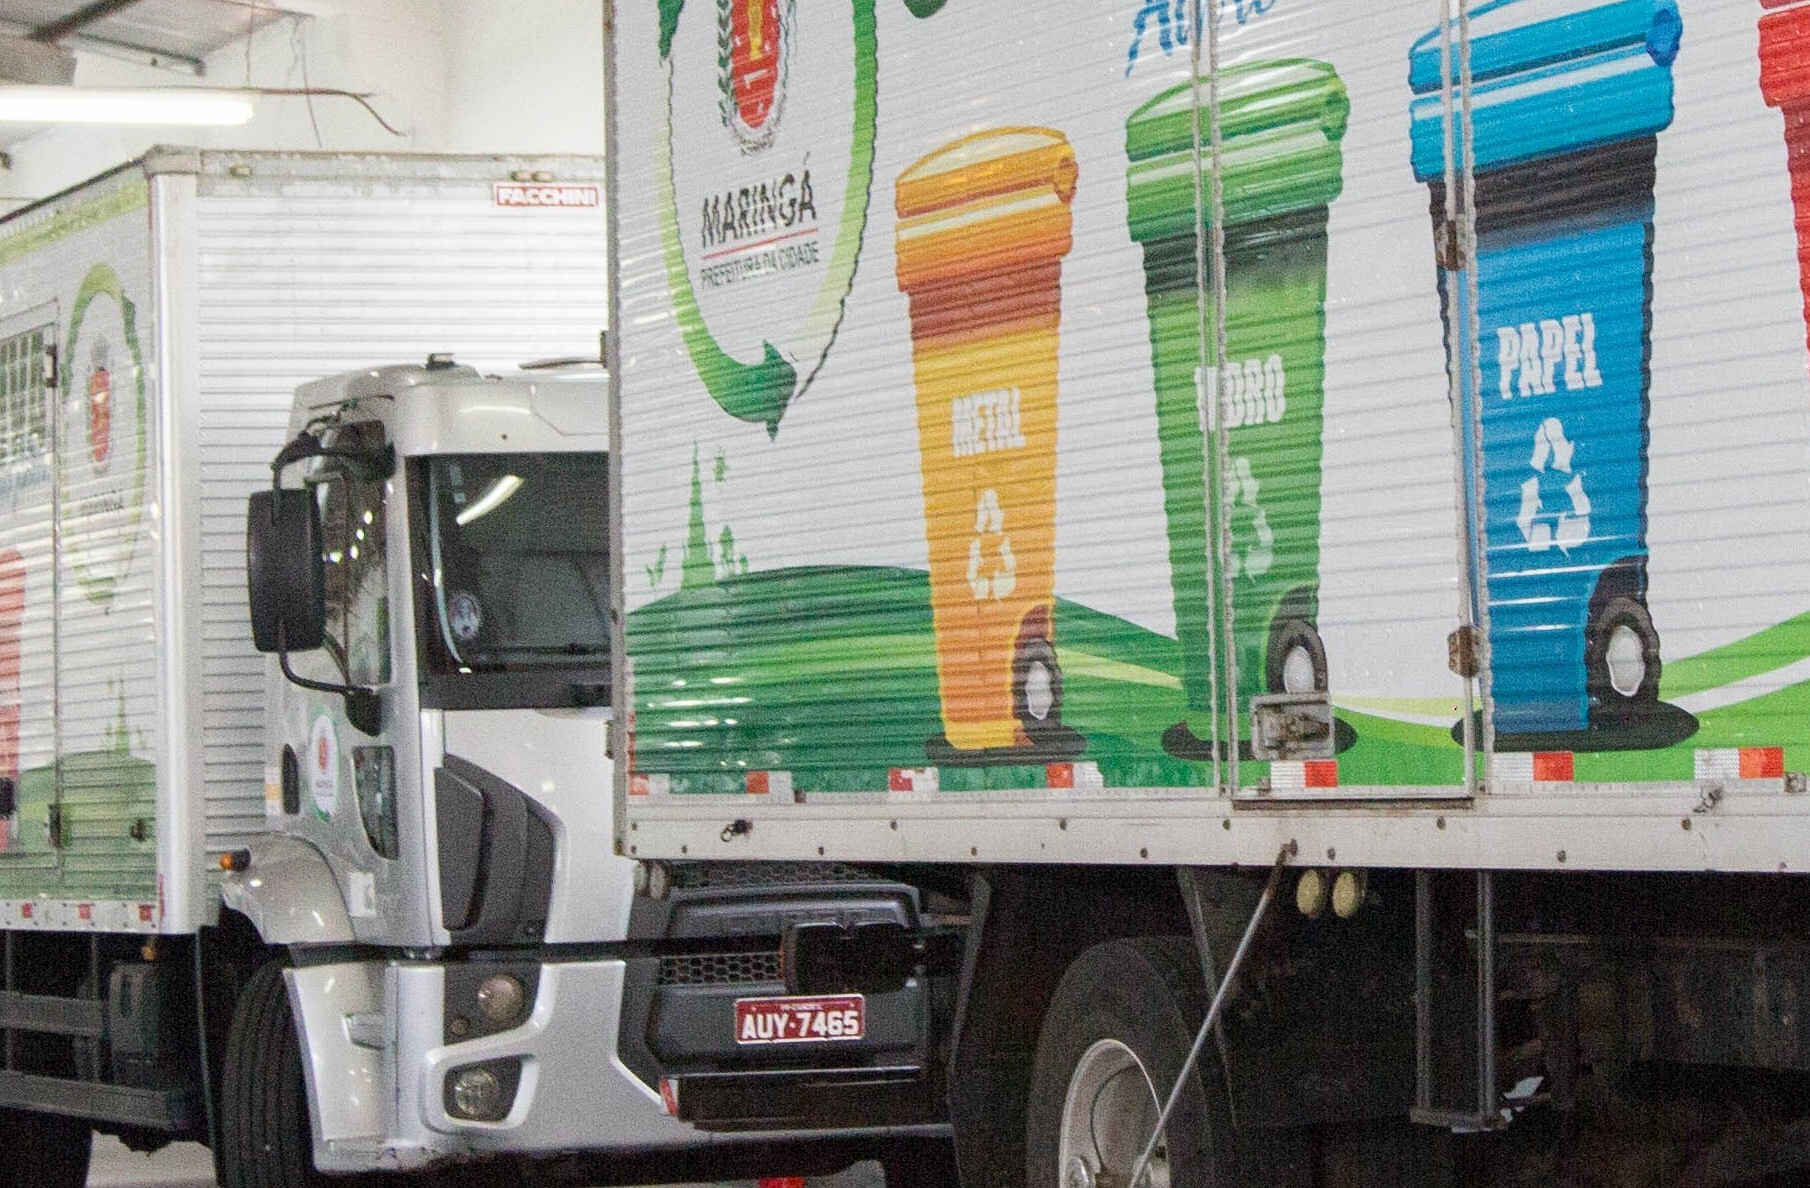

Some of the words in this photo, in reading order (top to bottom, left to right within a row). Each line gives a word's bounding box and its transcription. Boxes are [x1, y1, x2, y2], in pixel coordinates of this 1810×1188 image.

[499, 186, 596, 207] FACCHINI
[702, 150, 818, 249] MARINGÁ
[1496, 313, 1604, 401] PAPEL
[952, 386, 1027, 457] METAL
